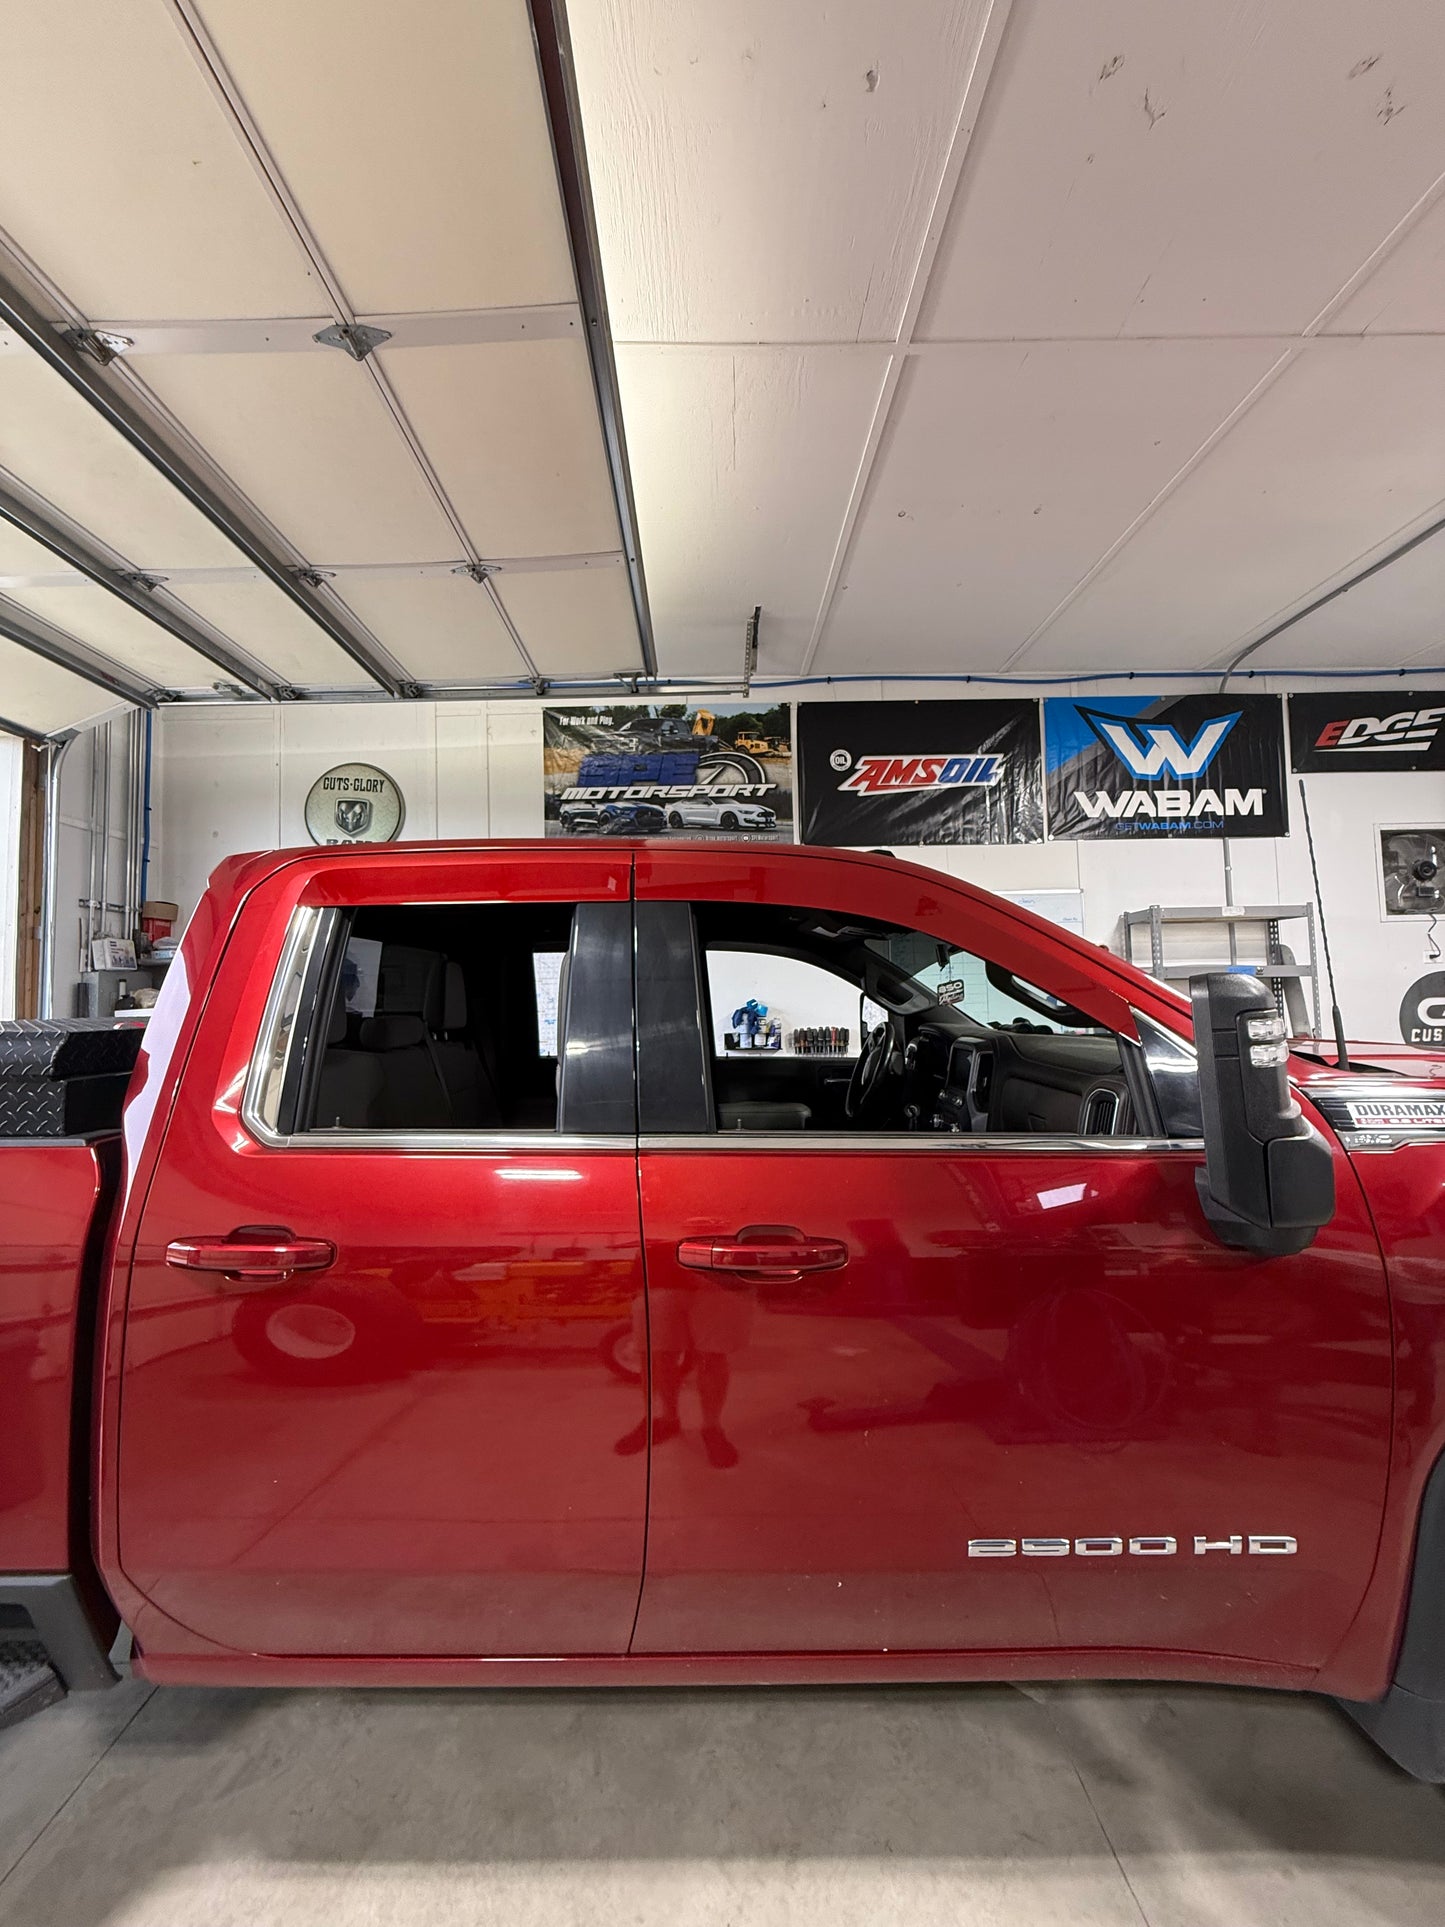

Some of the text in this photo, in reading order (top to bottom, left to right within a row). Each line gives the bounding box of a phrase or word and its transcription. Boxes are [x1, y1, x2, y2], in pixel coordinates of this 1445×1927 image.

[587, 714, 599, 725] and
[1315, 707, 1445, 747] EDGE
[577, 752, 701, 788] SPE
[848, 757, 1000, 793] AMSOIL
[560, 783, 777, 801] MOTORSPORT
[1073, 788, 1264, 818] WABAM
[1115, 819, 1225, 831] GETWABAM.COM
[1353, 1104, 1445, 1116] DURAMAX
[968, 1535, 1298, 1557] 2500 HD
